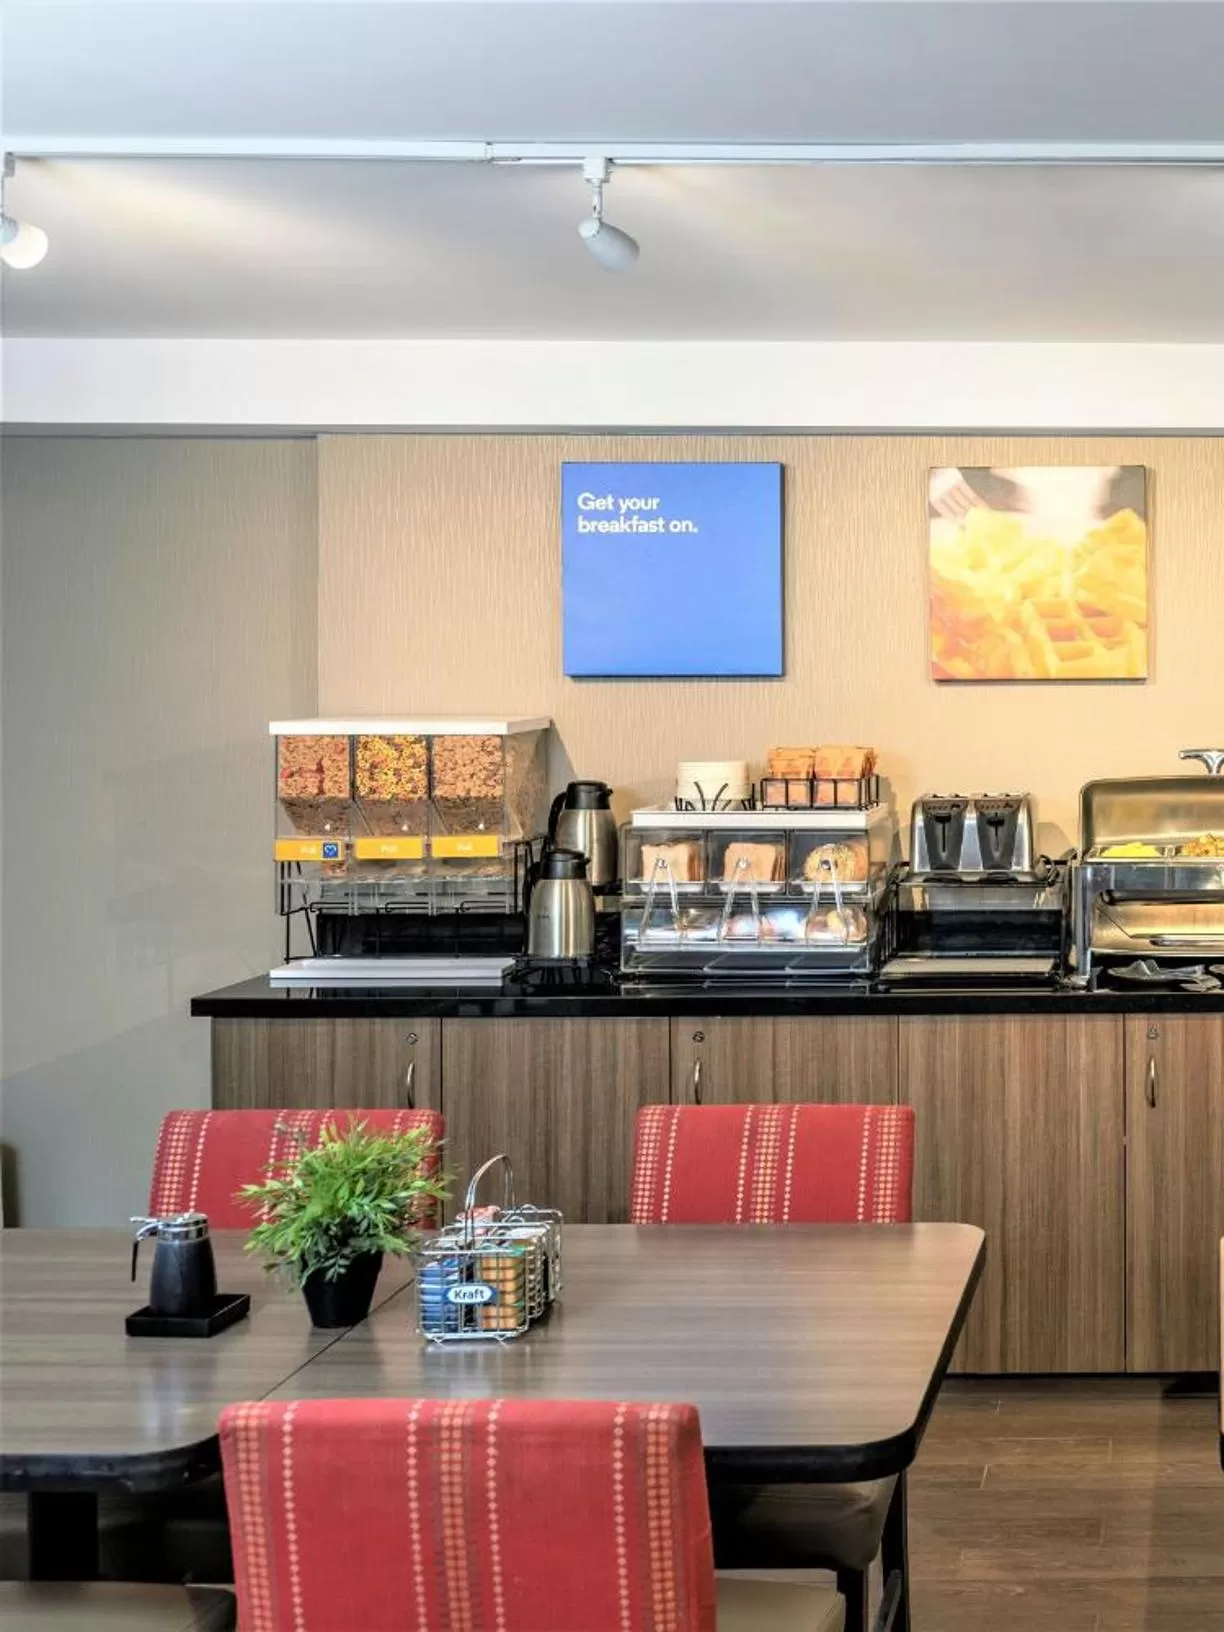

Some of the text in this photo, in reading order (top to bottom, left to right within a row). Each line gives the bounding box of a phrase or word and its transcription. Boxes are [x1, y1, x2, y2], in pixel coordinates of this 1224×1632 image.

[577, 492, 660, 513] Get your
[577, 515, 698, 533] breakfast on.
[453, 1288, 485, 1300] Kraft
